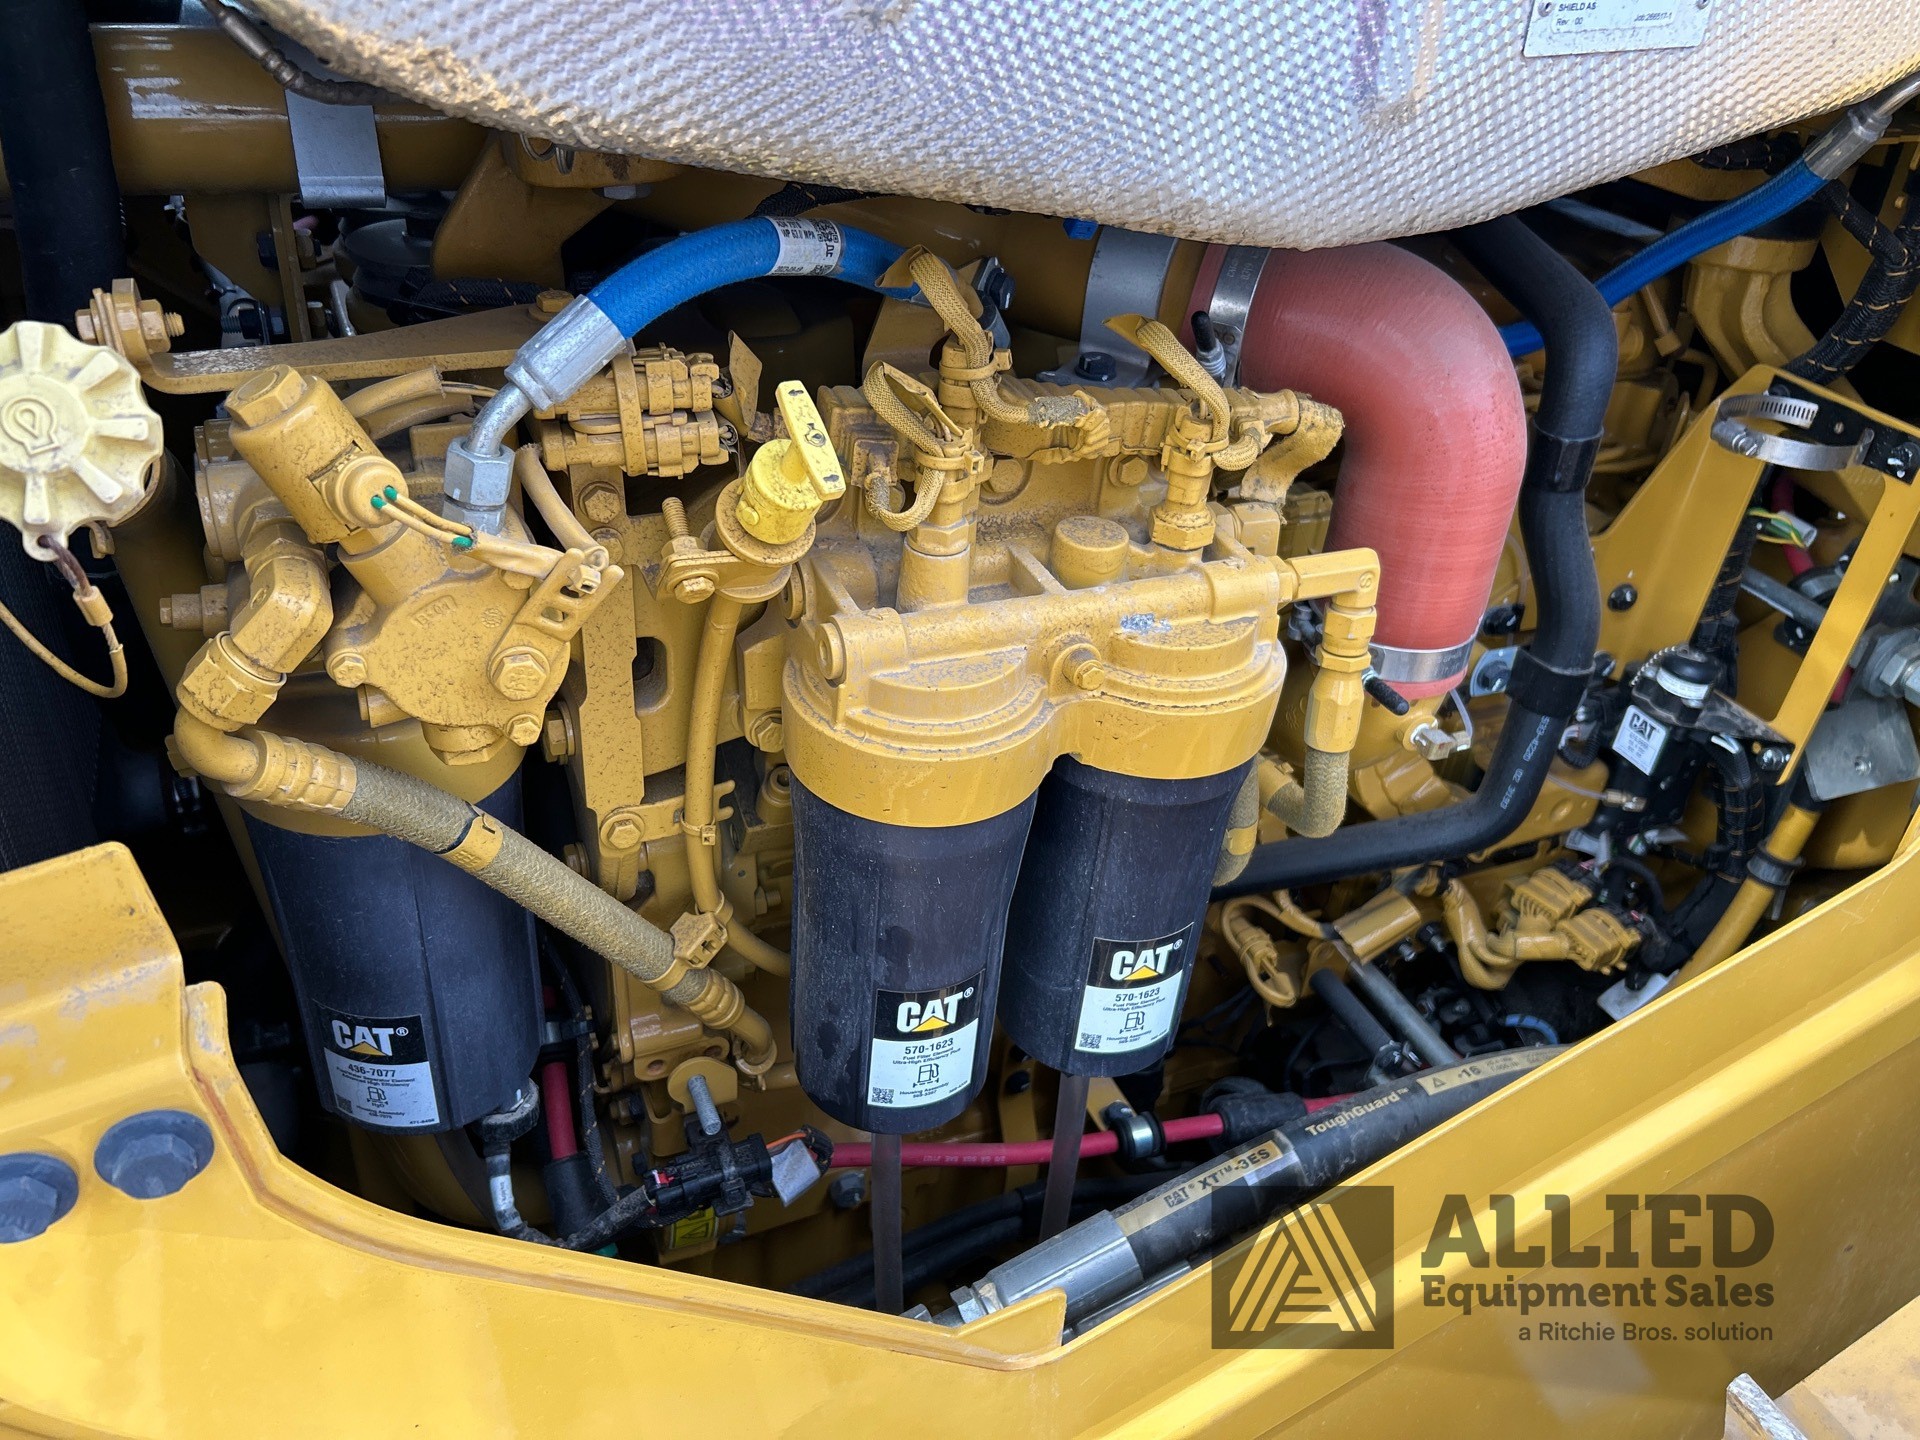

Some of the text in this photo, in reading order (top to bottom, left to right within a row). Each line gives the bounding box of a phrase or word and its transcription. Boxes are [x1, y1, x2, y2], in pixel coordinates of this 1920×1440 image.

[1558, 2, 1597, 11] SHIELD AS
[1629, 713, 1656, 741] CAT
[1115, 987, 1160, 1003] 570-1623
[905, 1037, 954, 1055] 570-1623
[348, 1063, 396, 1078] 436-7077
